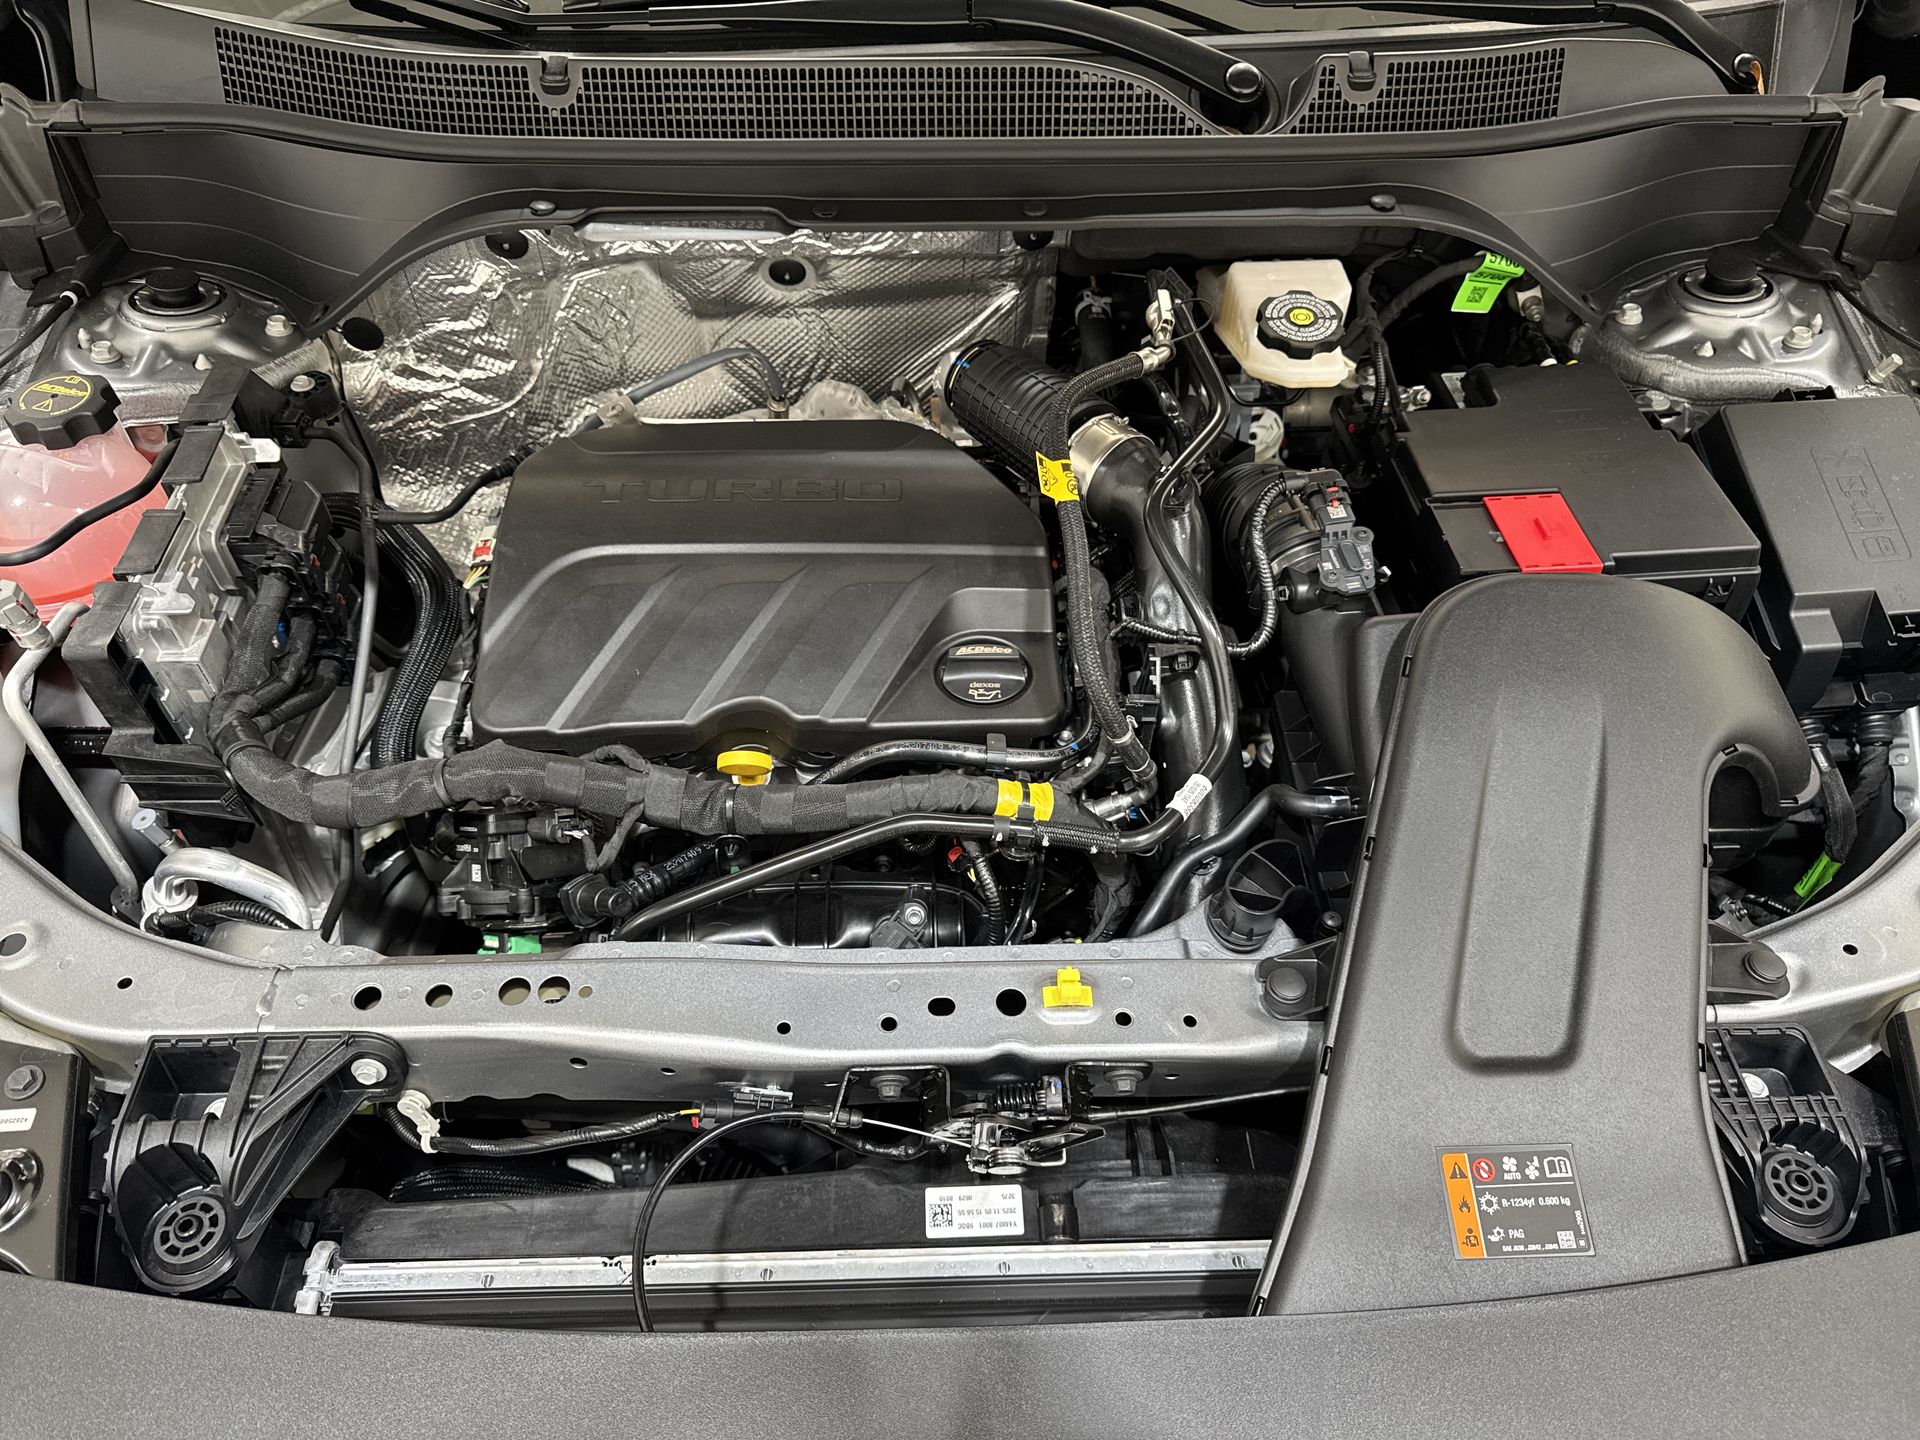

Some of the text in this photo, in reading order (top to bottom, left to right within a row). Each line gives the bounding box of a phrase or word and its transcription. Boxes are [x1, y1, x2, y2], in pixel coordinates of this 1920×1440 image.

[584, 478, 903, 503] TURBO
[955, 645, 1013, 656] ACDelco
[969, 681, 1001, 689] dexos
[1503, 1173, 1521, 1181] AUTO
[1501, 1197, 1571, 1208] R-1234yf 0.600 kg
[1508, 1229, 1525, 1239] PAG
